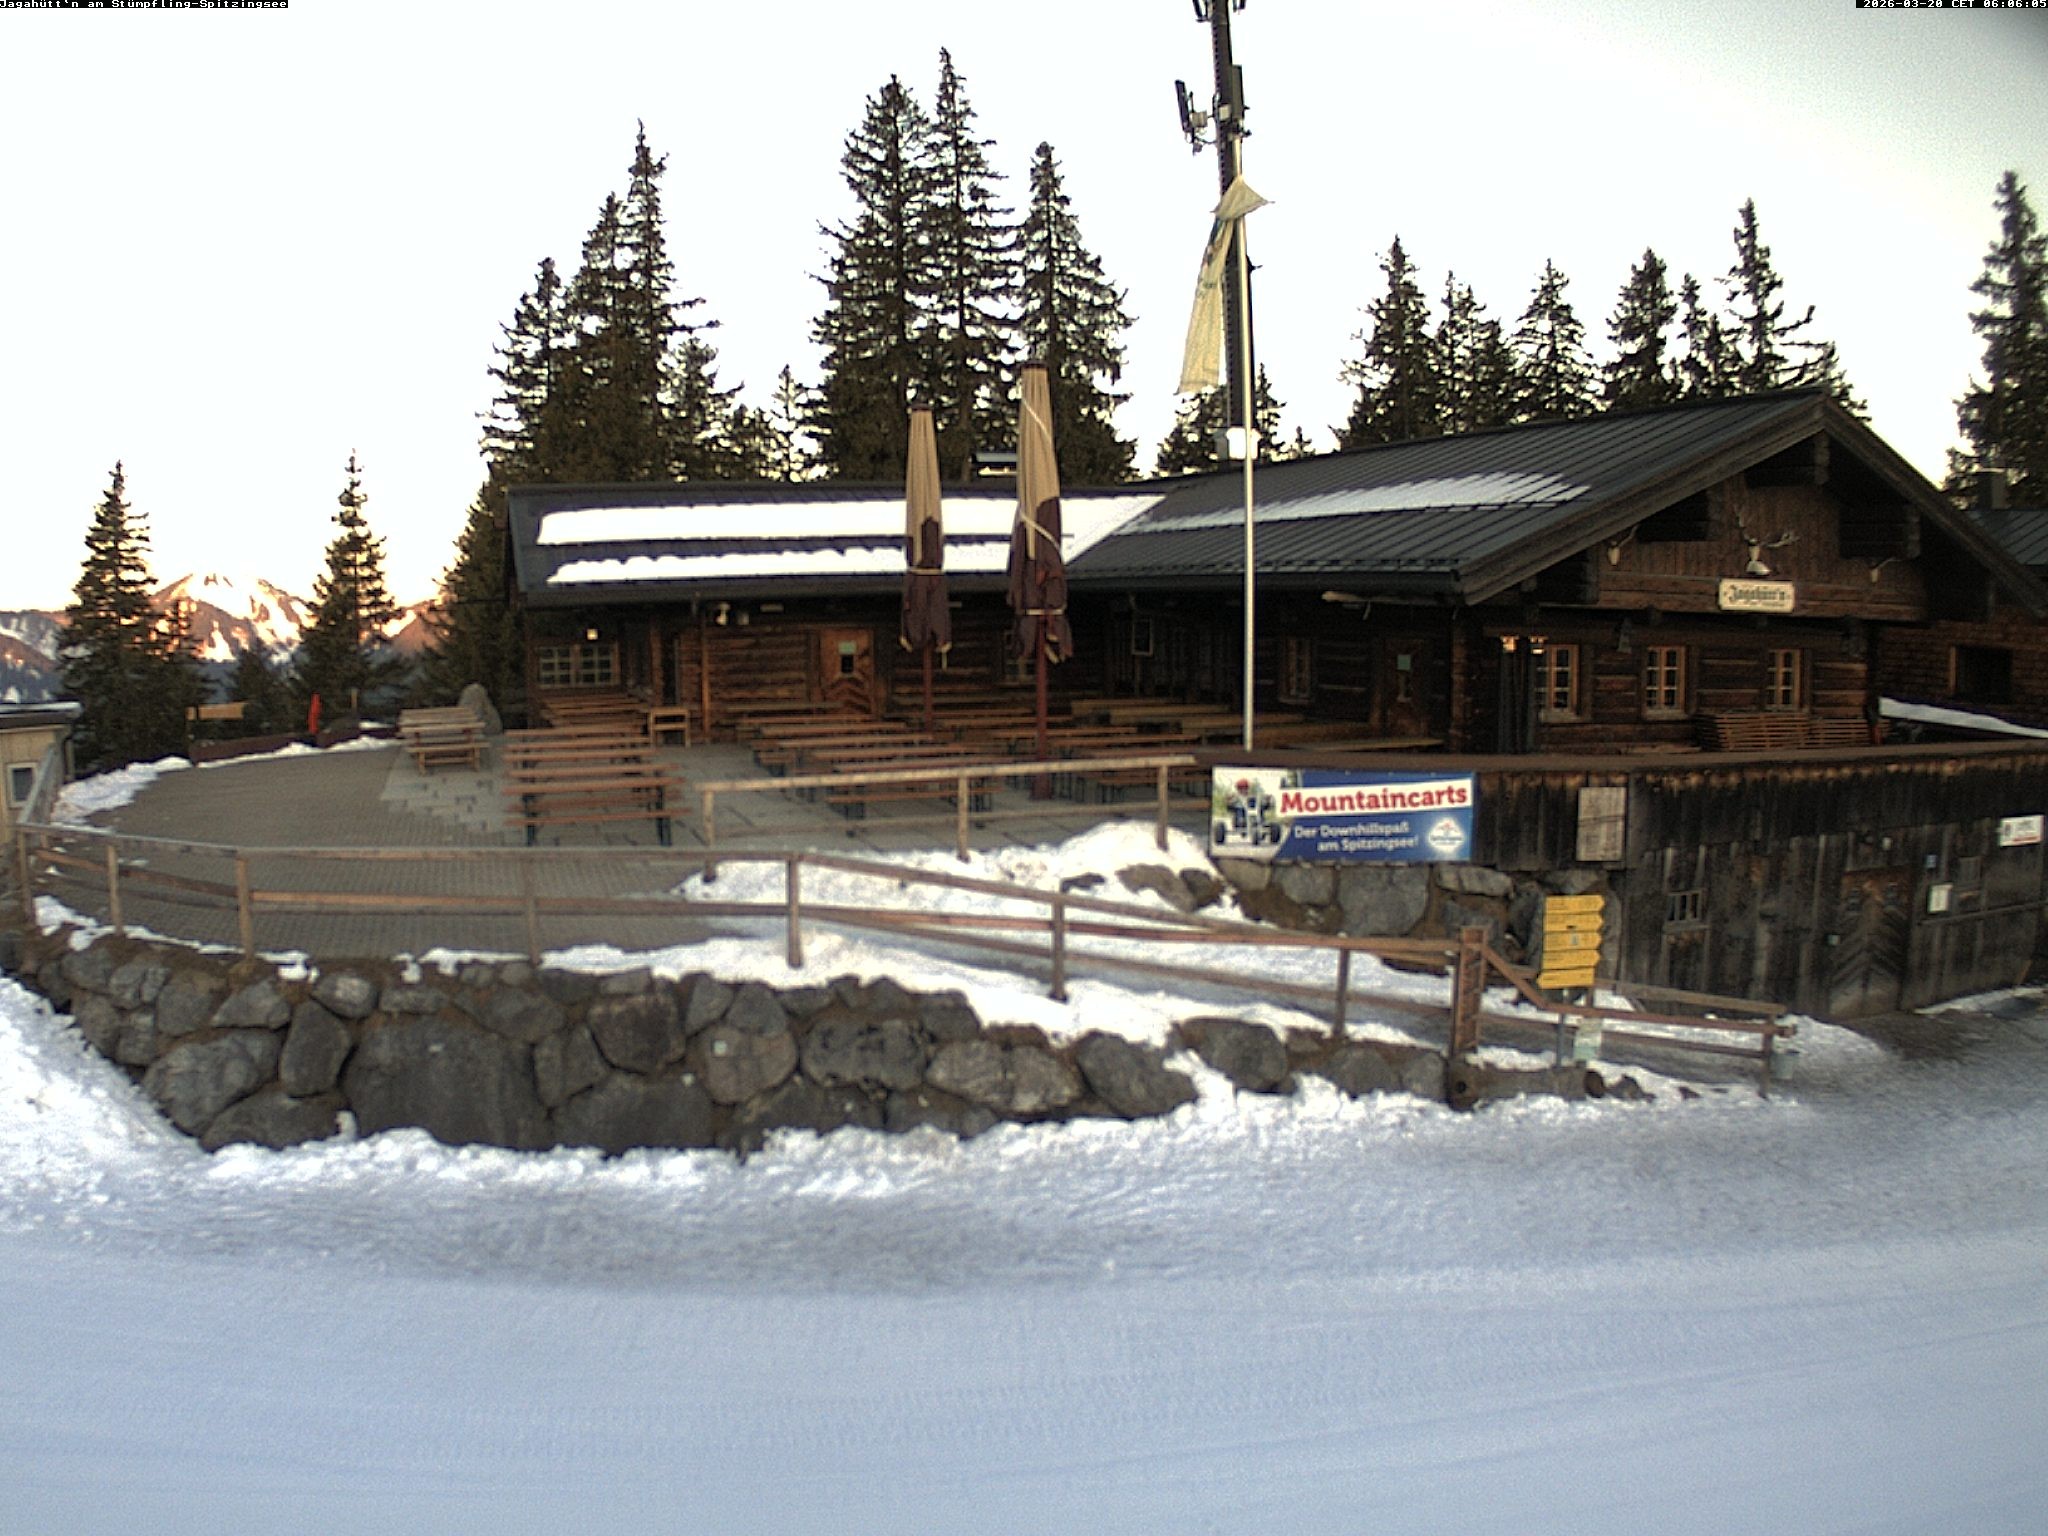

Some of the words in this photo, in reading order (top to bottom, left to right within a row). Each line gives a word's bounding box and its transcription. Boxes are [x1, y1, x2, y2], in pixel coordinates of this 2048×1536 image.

[1279, 785, 1468, 813] Mountaincarts
[1295, 824, 1316, 838] Der
[1320, 821, 1409, 838] Downhillspaß
[1317, 842, 1339, 852] am
